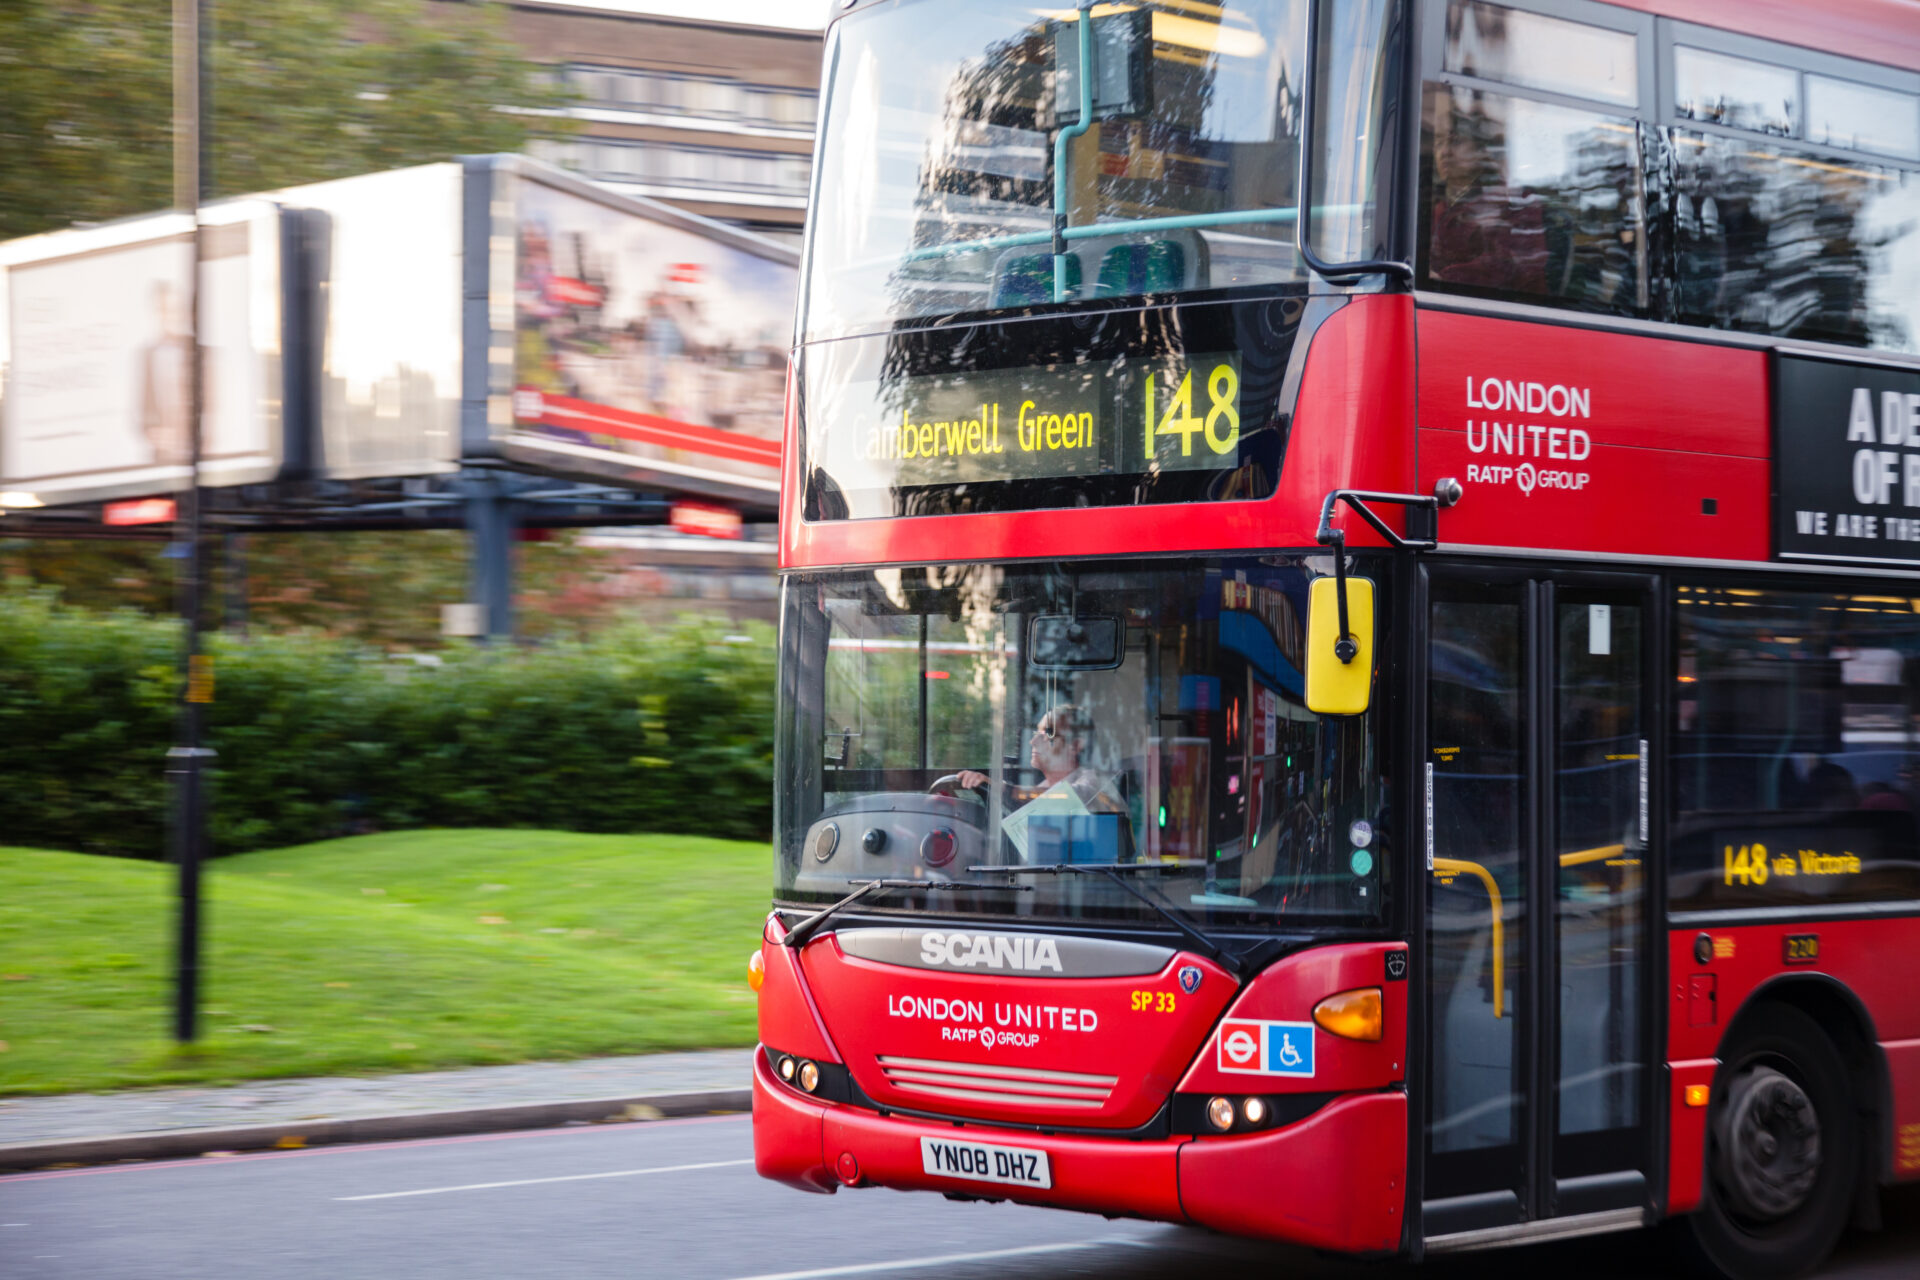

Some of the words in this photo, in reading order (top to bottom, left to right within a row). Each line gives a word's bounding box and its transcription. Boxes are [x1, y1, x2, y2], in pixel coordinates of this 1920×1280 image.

[1145, 364, 1240, 459] 148
[1466, 376, 1590, 418] LONDON
[1847, 387, 1877, 443] A
[1881, 391, 1920, 447] DE
[852, 402, 1003, 461] Camberwell
[1018, 400, 1093, 452] Green
[1466, 420, 1590, 461] UNITED
[1467, 464, 1513, 485] RATP
[1537, 469, 1590, 490] GROUP
[1853, 448, 1899, 504] OF
[1796, 510, 1828, 535] WE
[1835, 513, 1878, 538] ARE
[1884, 517, 1920, 541] THE
[1724, 843, 1768, 886] 148
[1771, 853, 1797, 876] via
[1798, 849, 1861, 875] Victoria
[921, 932, 1062, 972] SCANIA
[889, 994, 983, 1023] LONDON
[996, 1003, 1098, 1032] UNITED
[1131, 991, 1152, 1011] SP
[1156, 993, 1175, 1012] 33
[942, 1027, 977, 1042] RATP
[997, 1032, 1039, 1047] GROUP
[929, 1143, 988, 1175] YN08
[994, 1152, 1041, 1181] DHZ
